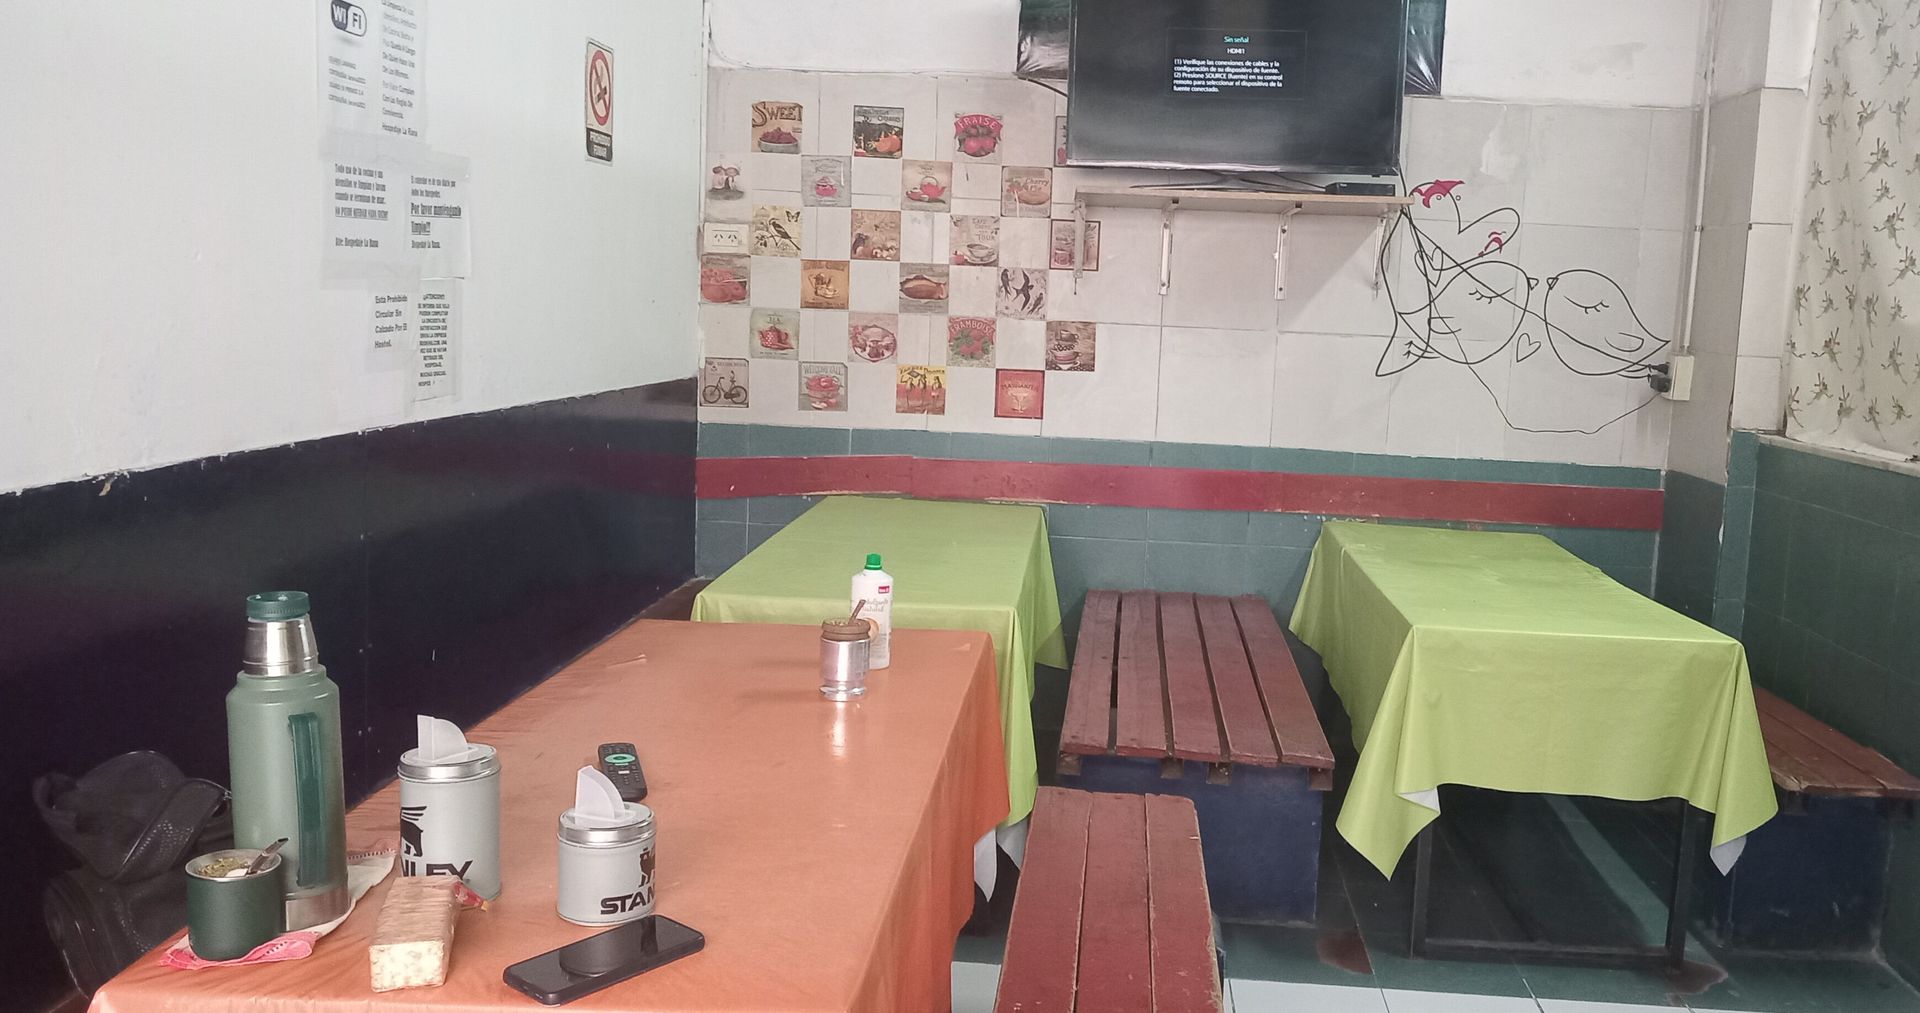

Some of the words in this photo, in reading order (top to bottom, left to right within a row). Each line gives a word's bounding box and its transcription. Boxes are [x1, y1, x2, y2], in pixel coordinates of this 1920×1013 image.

[957, 116, 998, 129] FRAISE
[1025, 177, 1049, 187] Cherry
[387, 294, 407, 303] Prohibido
[375, 310, 394, 318] Circular
[950, 320, 992, 337] FRAMBOISE
